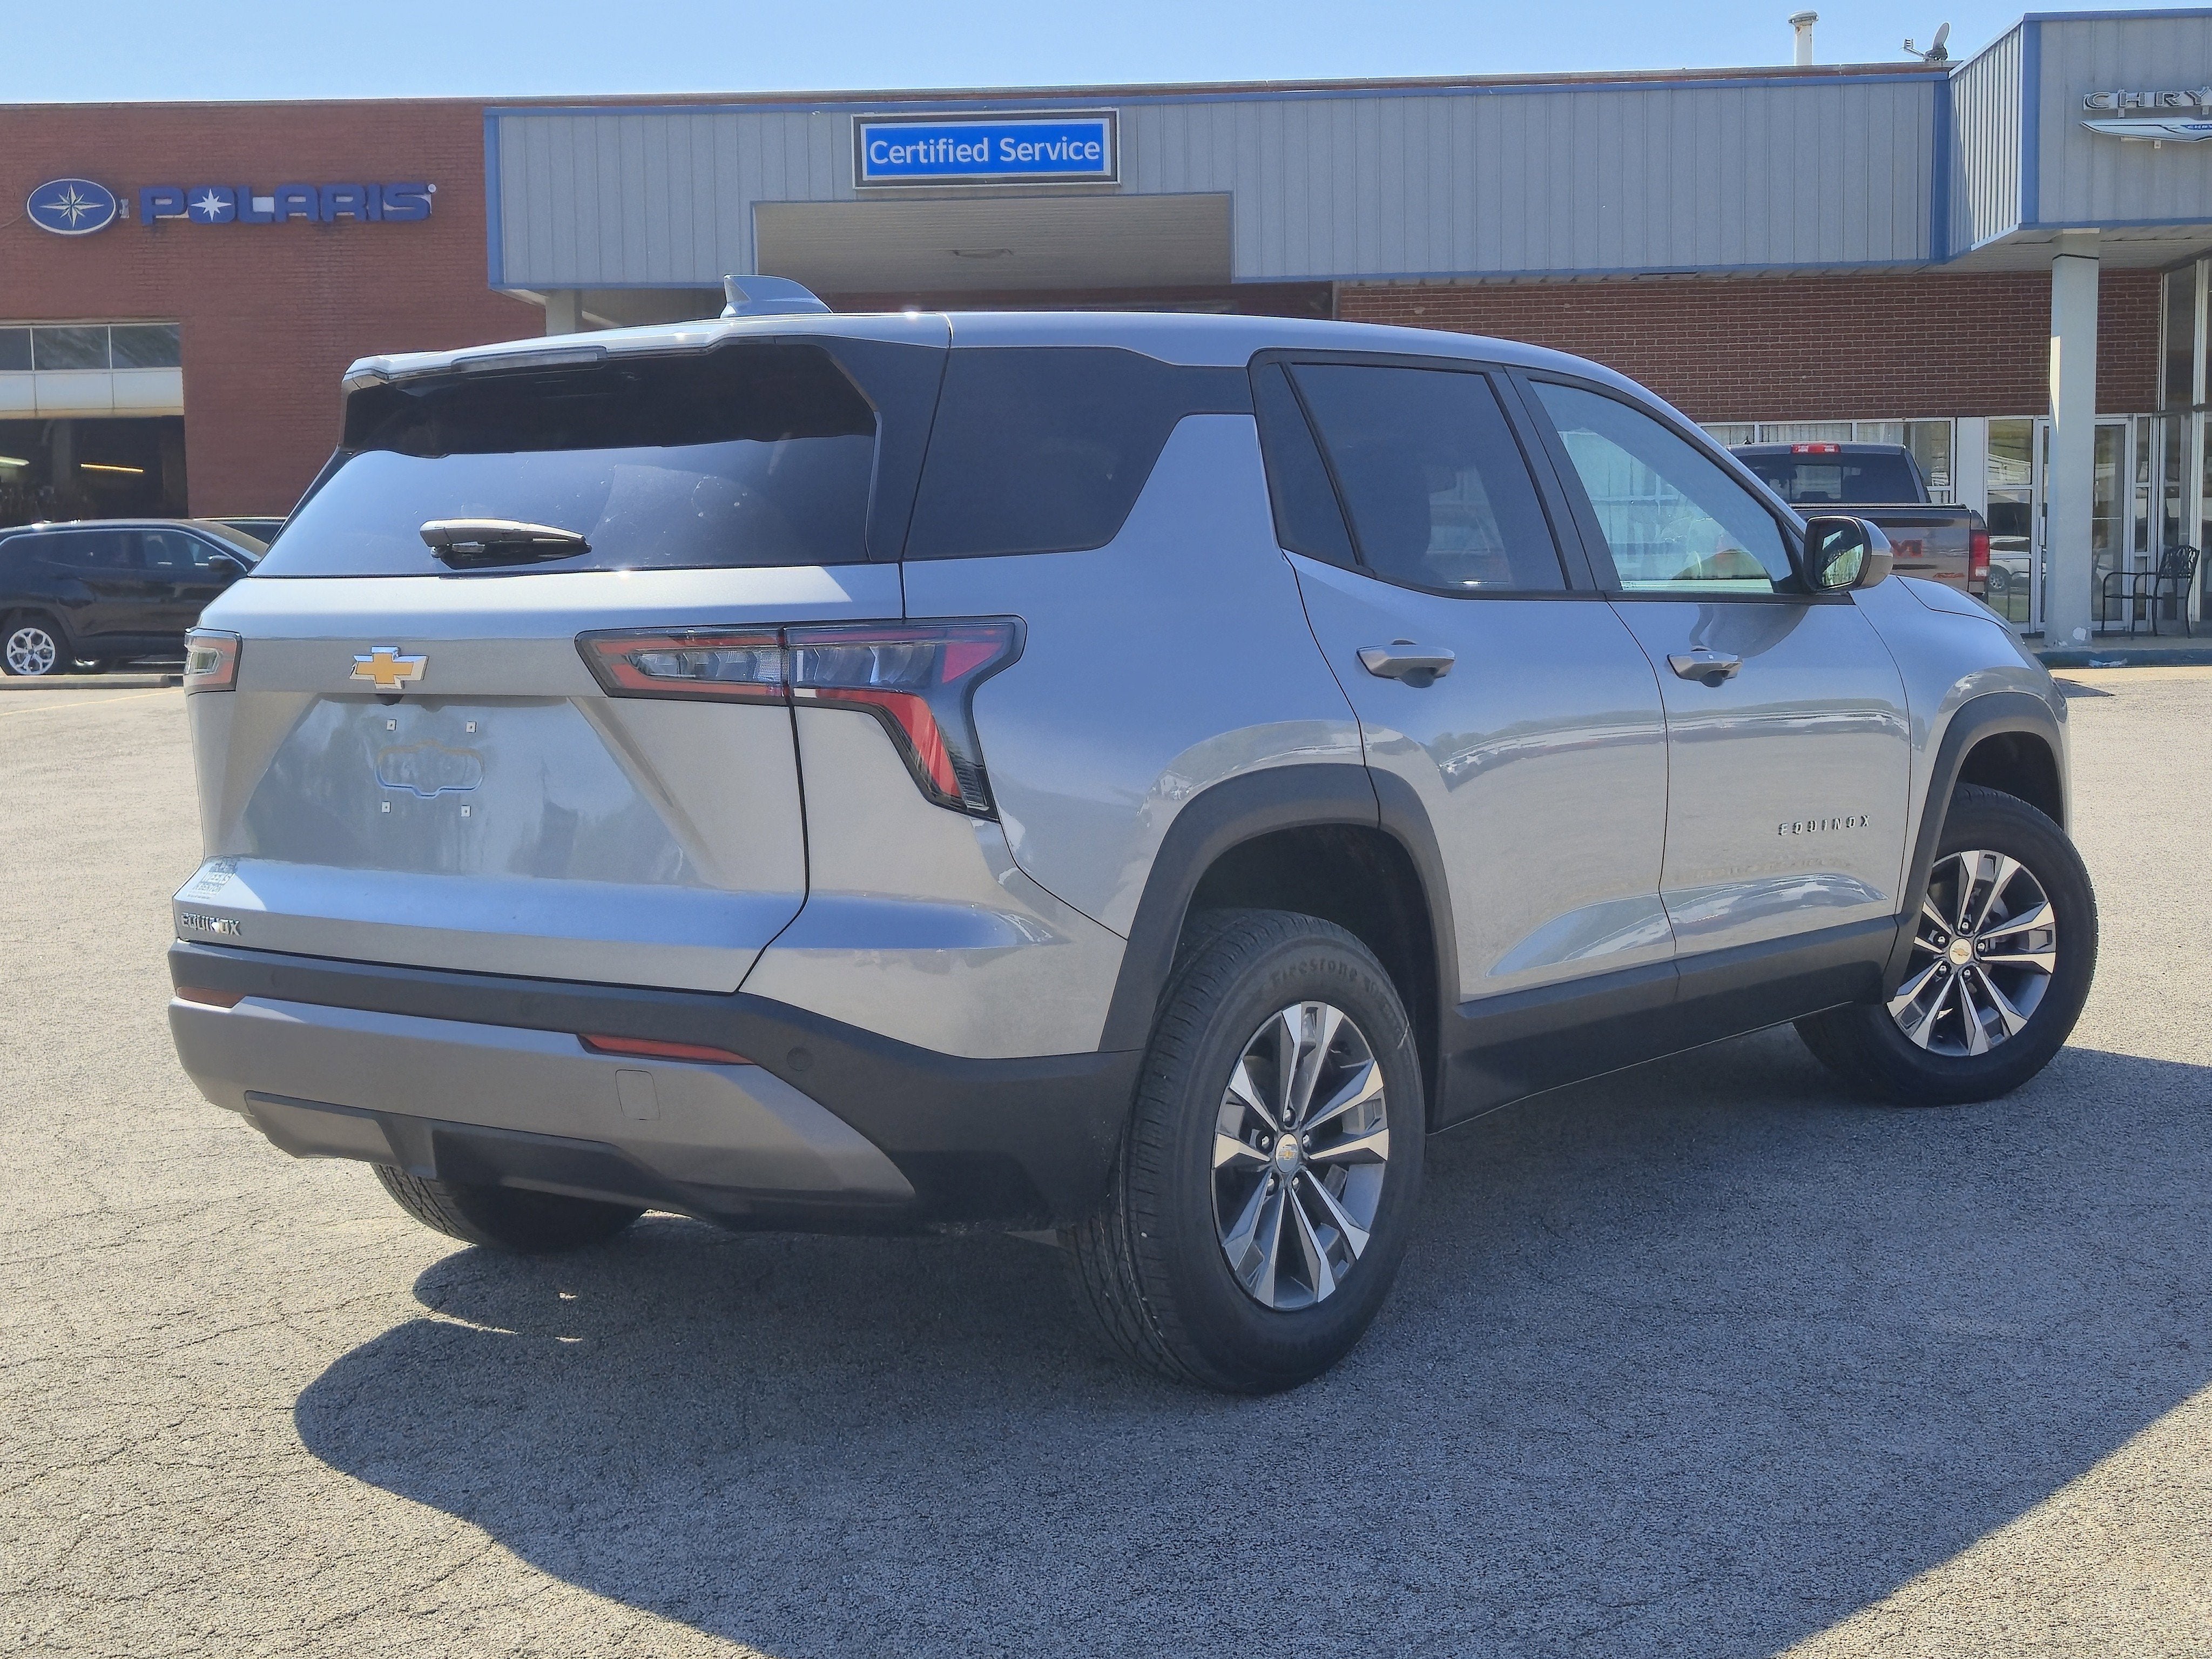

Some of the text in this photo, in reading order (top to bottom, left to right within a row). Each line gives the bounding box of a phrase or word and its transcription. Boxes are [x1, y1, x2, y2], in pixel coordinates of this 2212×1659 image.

[2084, 90, 2212, 109] CHRY
[869, 136, 1100, 164] Certified Service
[139, 183, 433, 226] POLARIS
[1778, 814, 1870, 836] EQUINOX
[181, 912, 242, 936] EQUINOX
